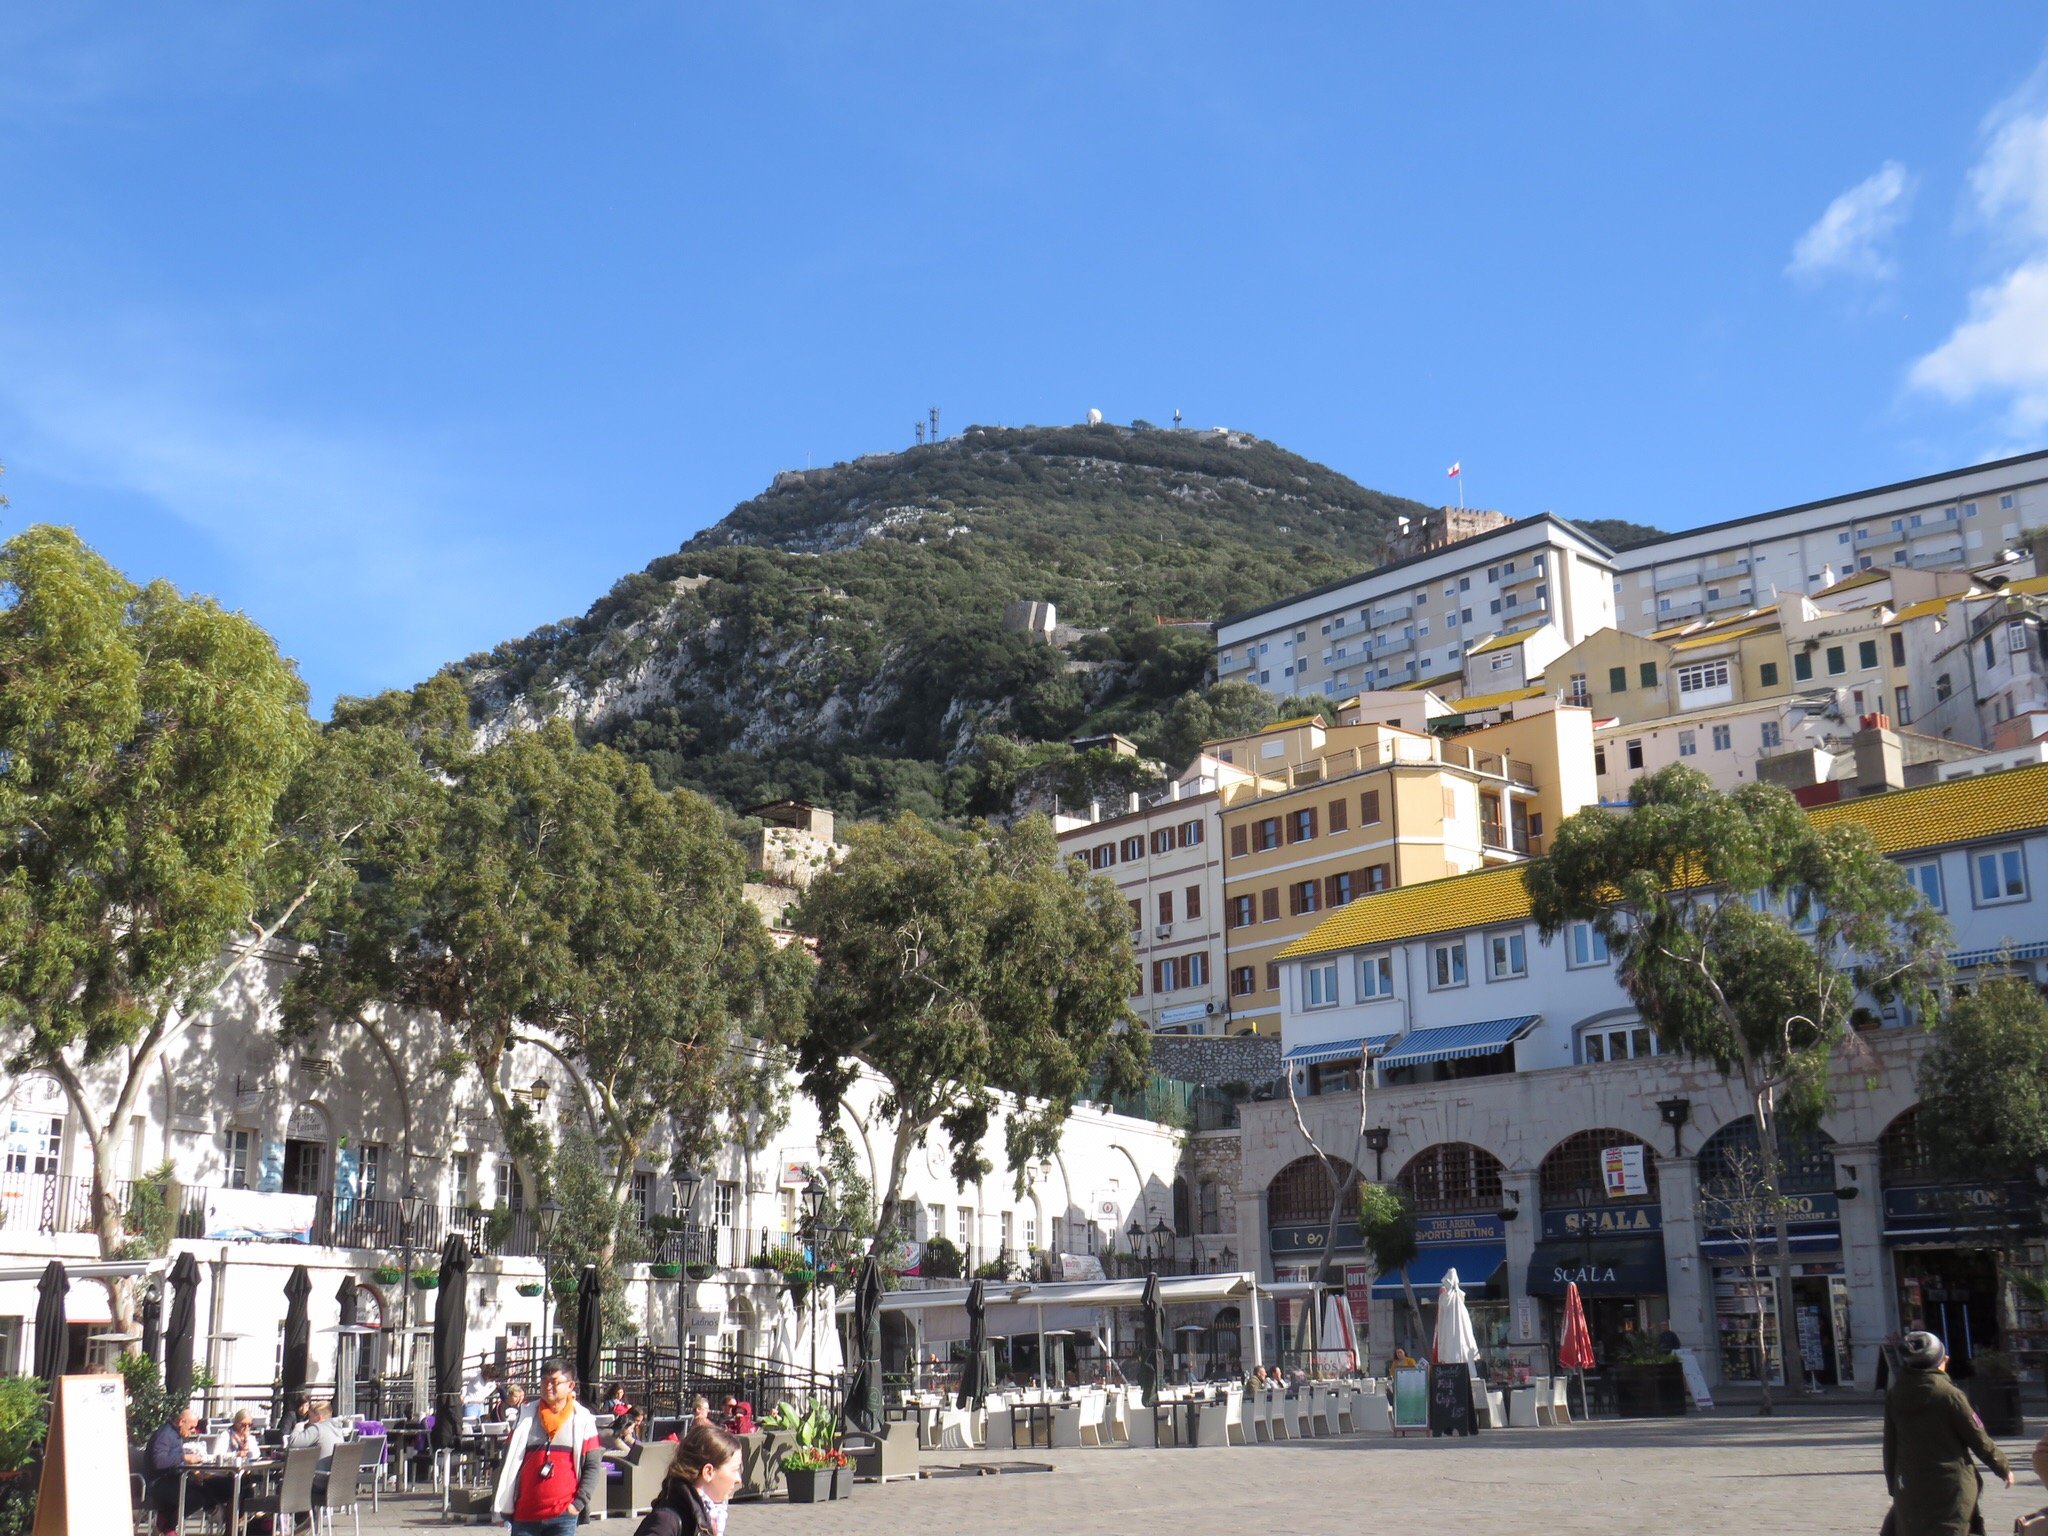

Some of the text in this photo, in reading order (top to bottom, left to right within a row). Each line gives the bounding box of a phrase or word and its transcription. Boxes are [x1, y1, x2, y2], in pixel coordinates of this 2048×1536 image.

[1432, 1219, 1476, 1230] THE ARENA
[1416, 1227, 1494, 1240] SPORTS BETTING
[1553, 1266, 1616, 1282] SCALA
[691, 1315, 719, 1326] Latino's
